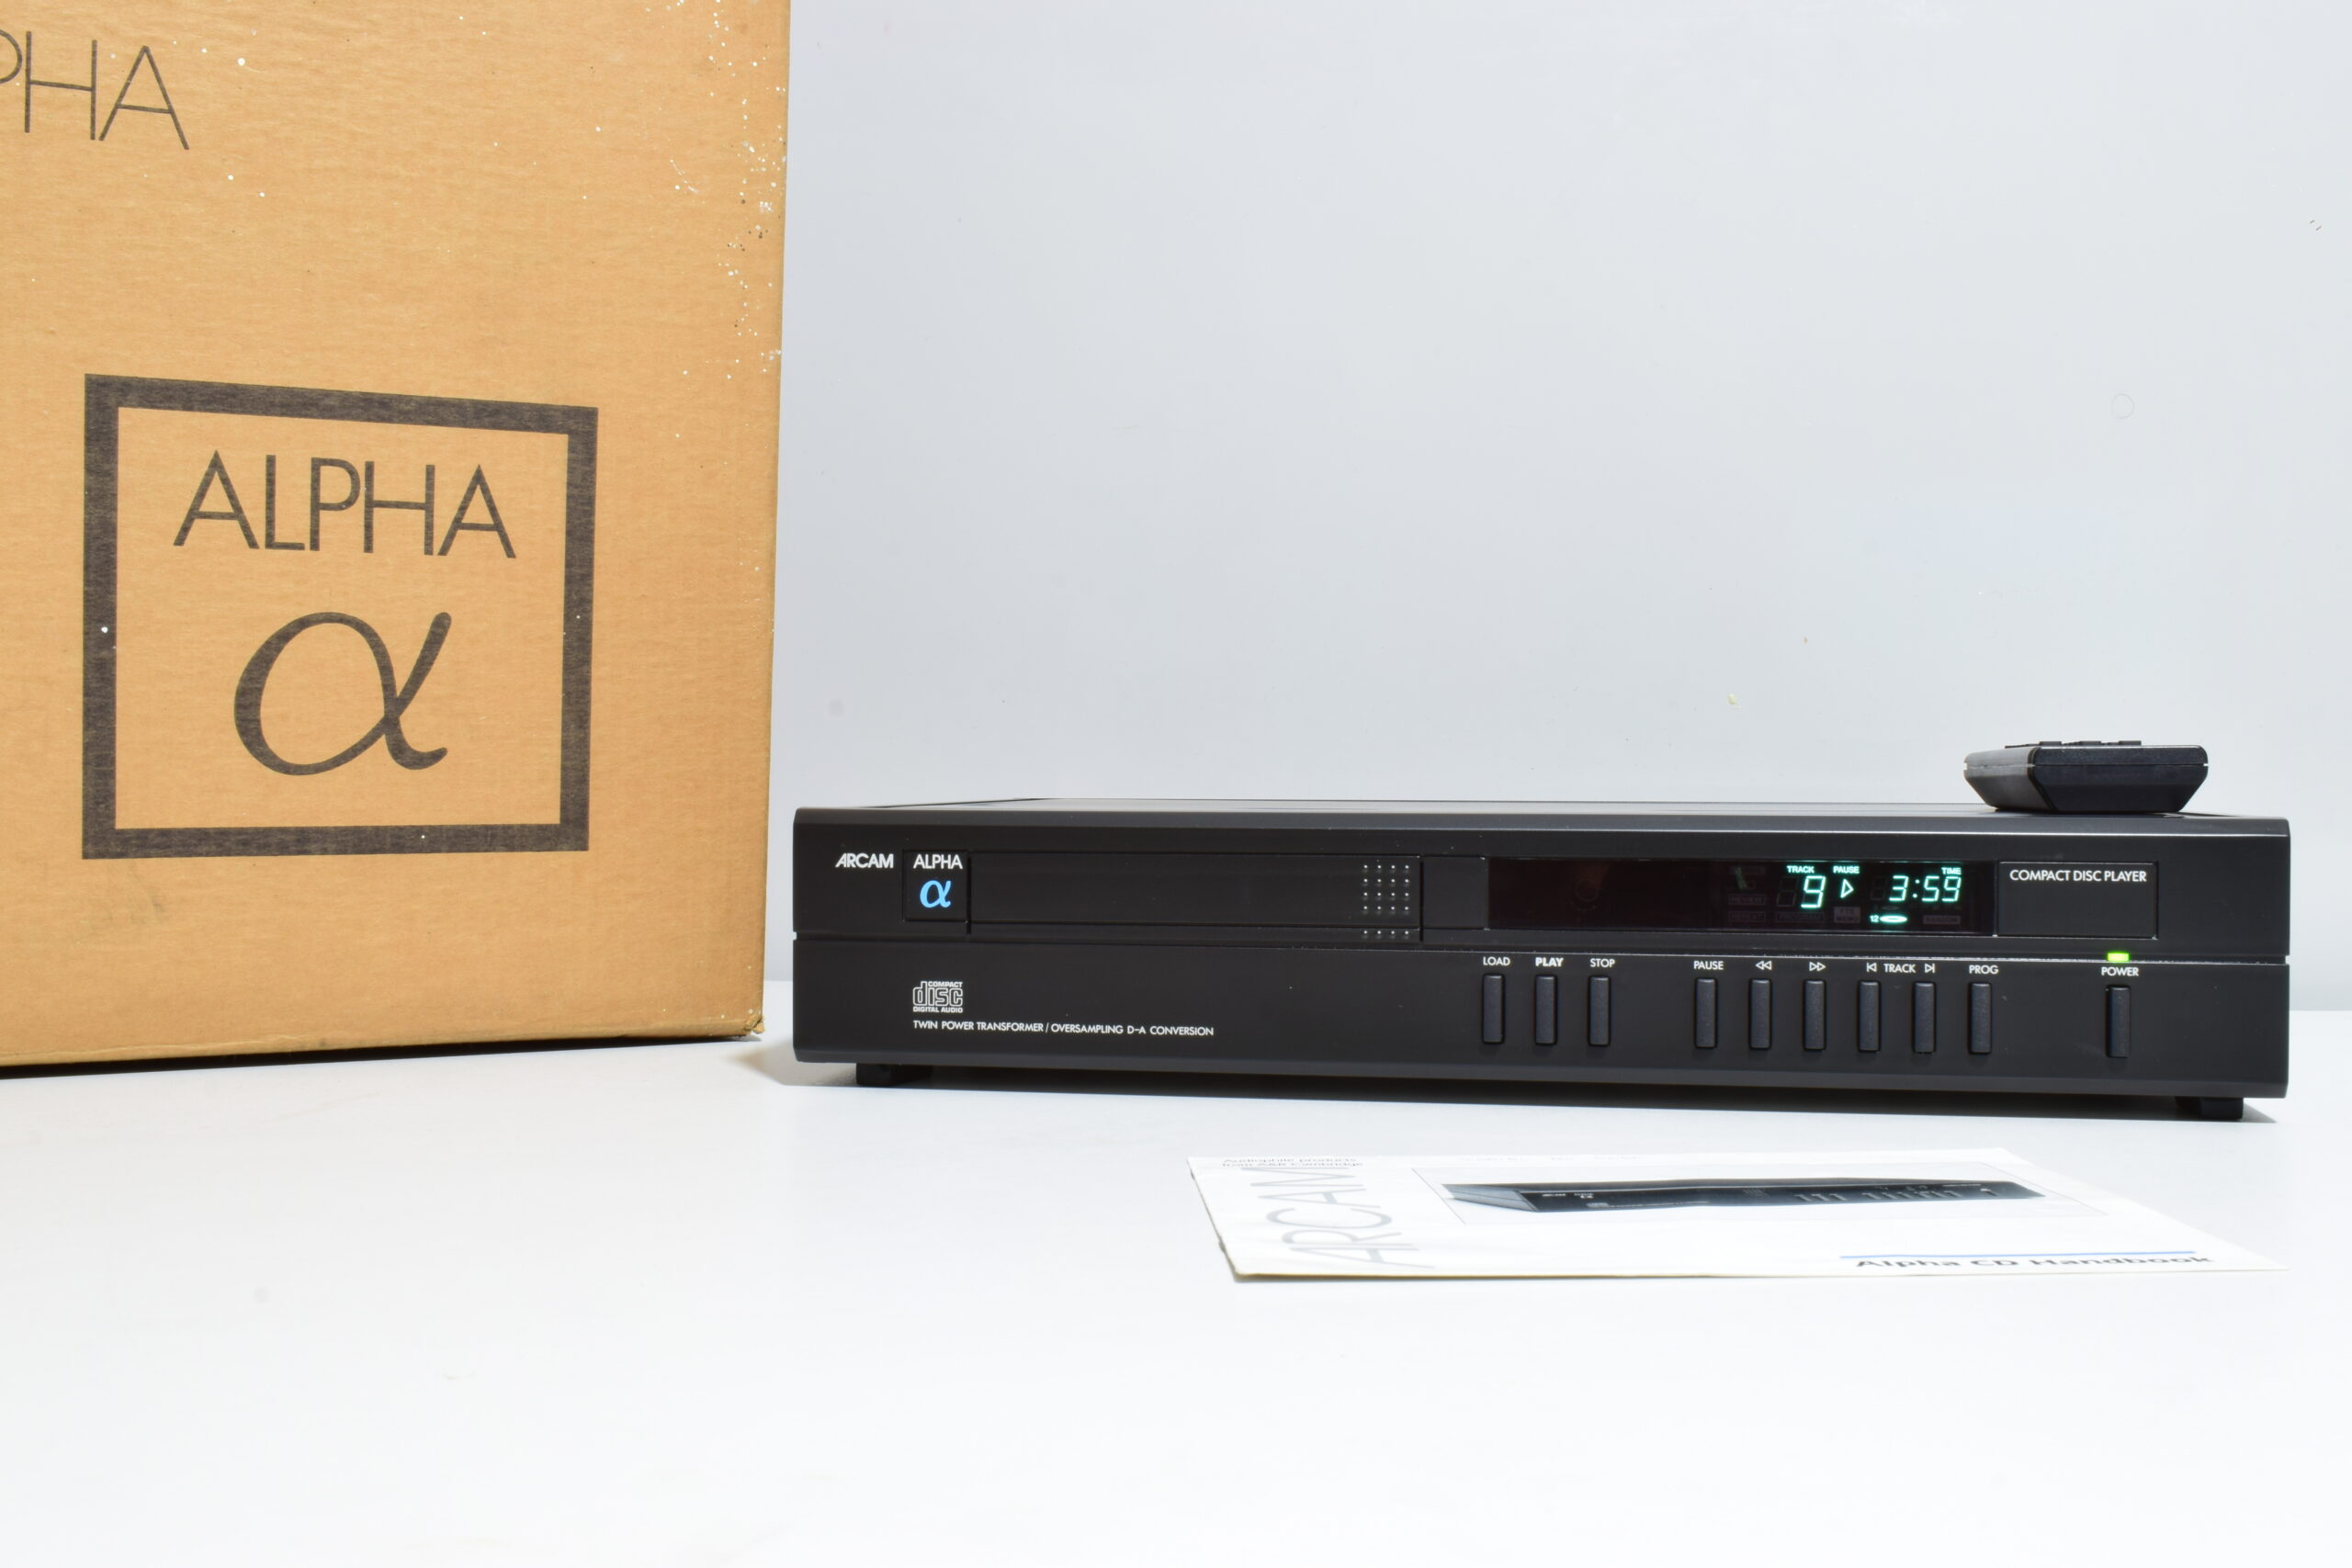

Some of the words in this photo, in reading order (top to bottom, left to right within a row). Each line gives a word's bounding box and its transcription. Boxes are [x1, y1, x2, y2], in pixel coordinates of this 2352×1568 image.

[173, 450, 516, 558] ALPHA
[835, 853, 894, 868] ARCAM
[913, 854, 963, 869] ALPHA
[1787, 865, 1815, 874] TRACK
[1832, 865, 1860, 874] PAUSE
[2009, 870, 2071, 882] COMPACT
[2073, 870, 2102, 882] DISC
[2104, 871, 2147, 883] PLAYER
[1801, 875, 1826, 908] 9
[1889, 875, 1962, 901] 3:59
[1483, 956, 1510, 966] LOAD
[1535, 957, 1564, 967] PLAY
[1589, 958, 1615, 968] STOP
[1693, 960, 1724, 970] PAUSE
[1883, 964, 1916, 974] TRACK
[1969, 964, 1999, 975] PROG
[2101, 966, 2139, 976] POWER
[912, 981, 964, 1007] disc
[913, 1020, 938, 1030] TWIN
[942, 1021, 975, 1031] POWER
[977, 1021, 1044, 1032] TRANSFORMER
[1051, 1022, 1124, 1034] OVERSAMPLING
[1149, 1025, 1214, 1036] CONVERSION
[1241, 1168, 1436, 1269] ARCAM
[2030, 1257, 2214, 1266] Handbook
